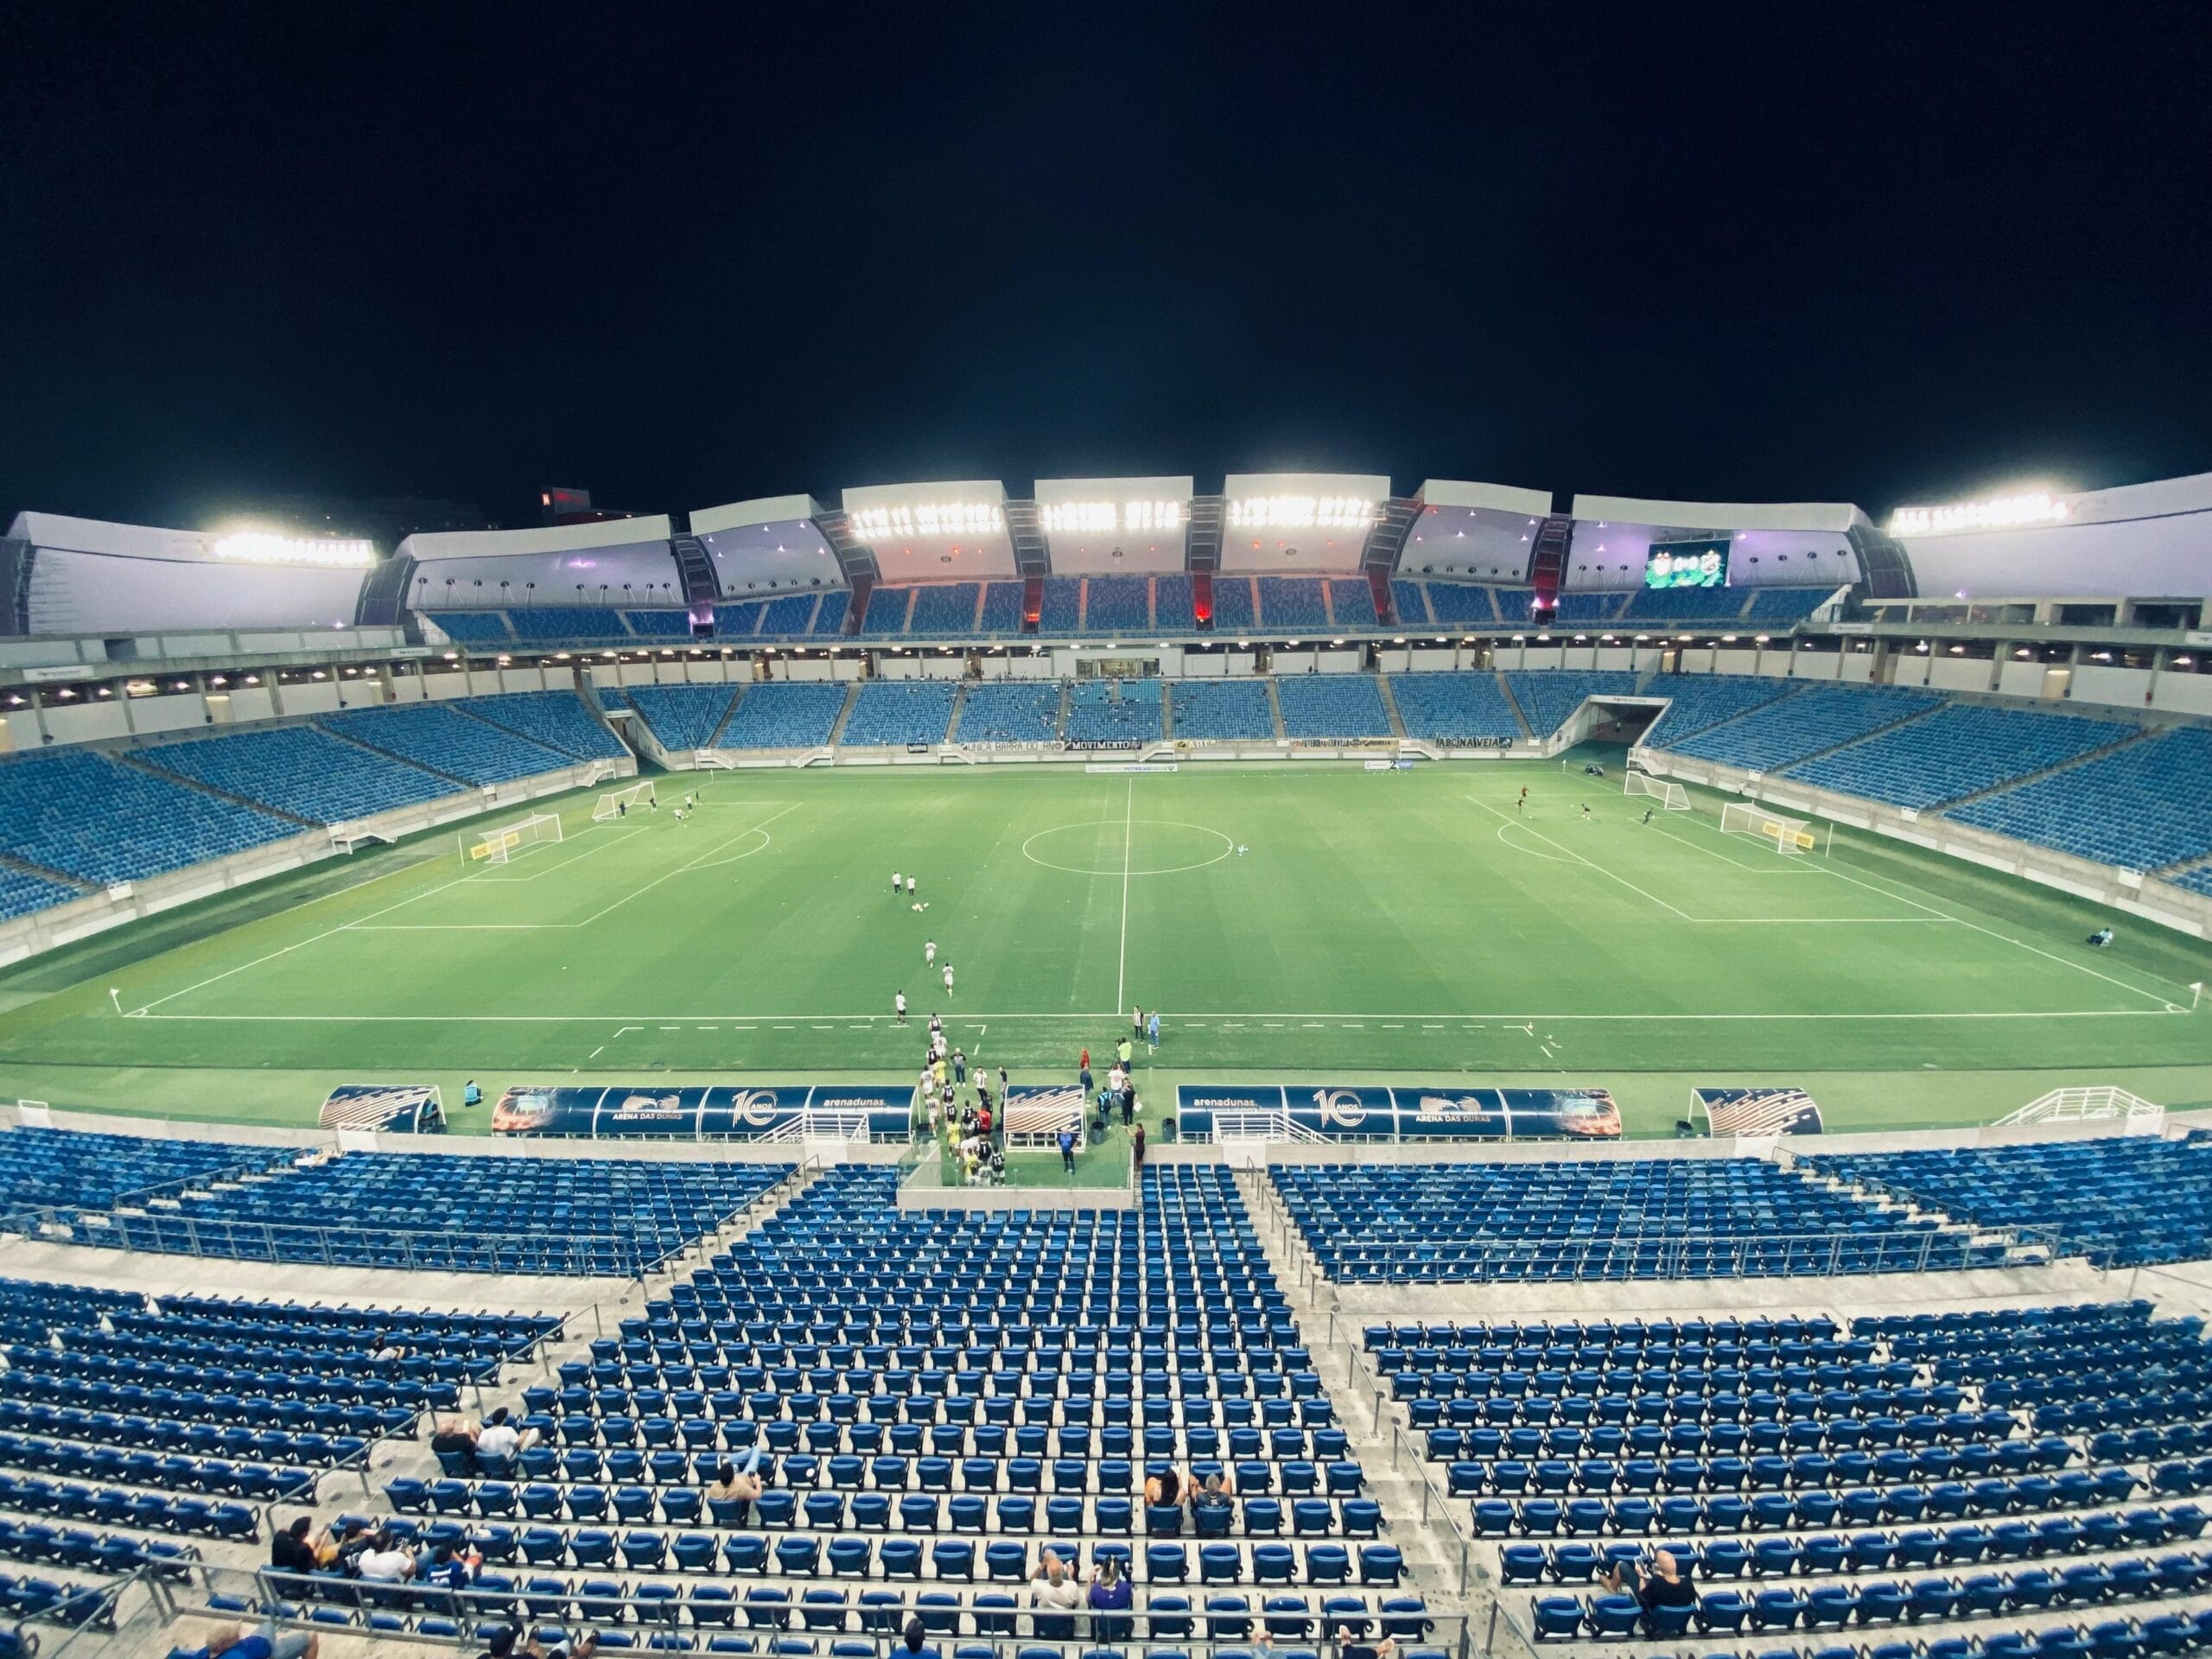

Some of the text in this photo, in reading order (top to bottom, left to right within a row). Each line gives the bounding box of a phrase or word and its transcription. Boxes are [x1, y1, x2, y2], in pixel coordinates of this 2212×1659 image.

[995, 741, 1023, 751] BARRA
[1026, 741, 1038, 751] DO
[1042, 741, 1054, 751] RN
[1072, 741, 1130, 750] MOVIMENTO
[1439, 738, 1500, 747] ABC NA VEIA
[731, 1089, 779, 1128] 10
[1313, 1089, 1367, 1129] 10
[1337, 1103, 1359, 1112] ANOS
[612, 1112, 683, 1121] ARENA DAS DUNAS
[1415, 1115, 1491, 1123] ARENA DAS DUNAS
